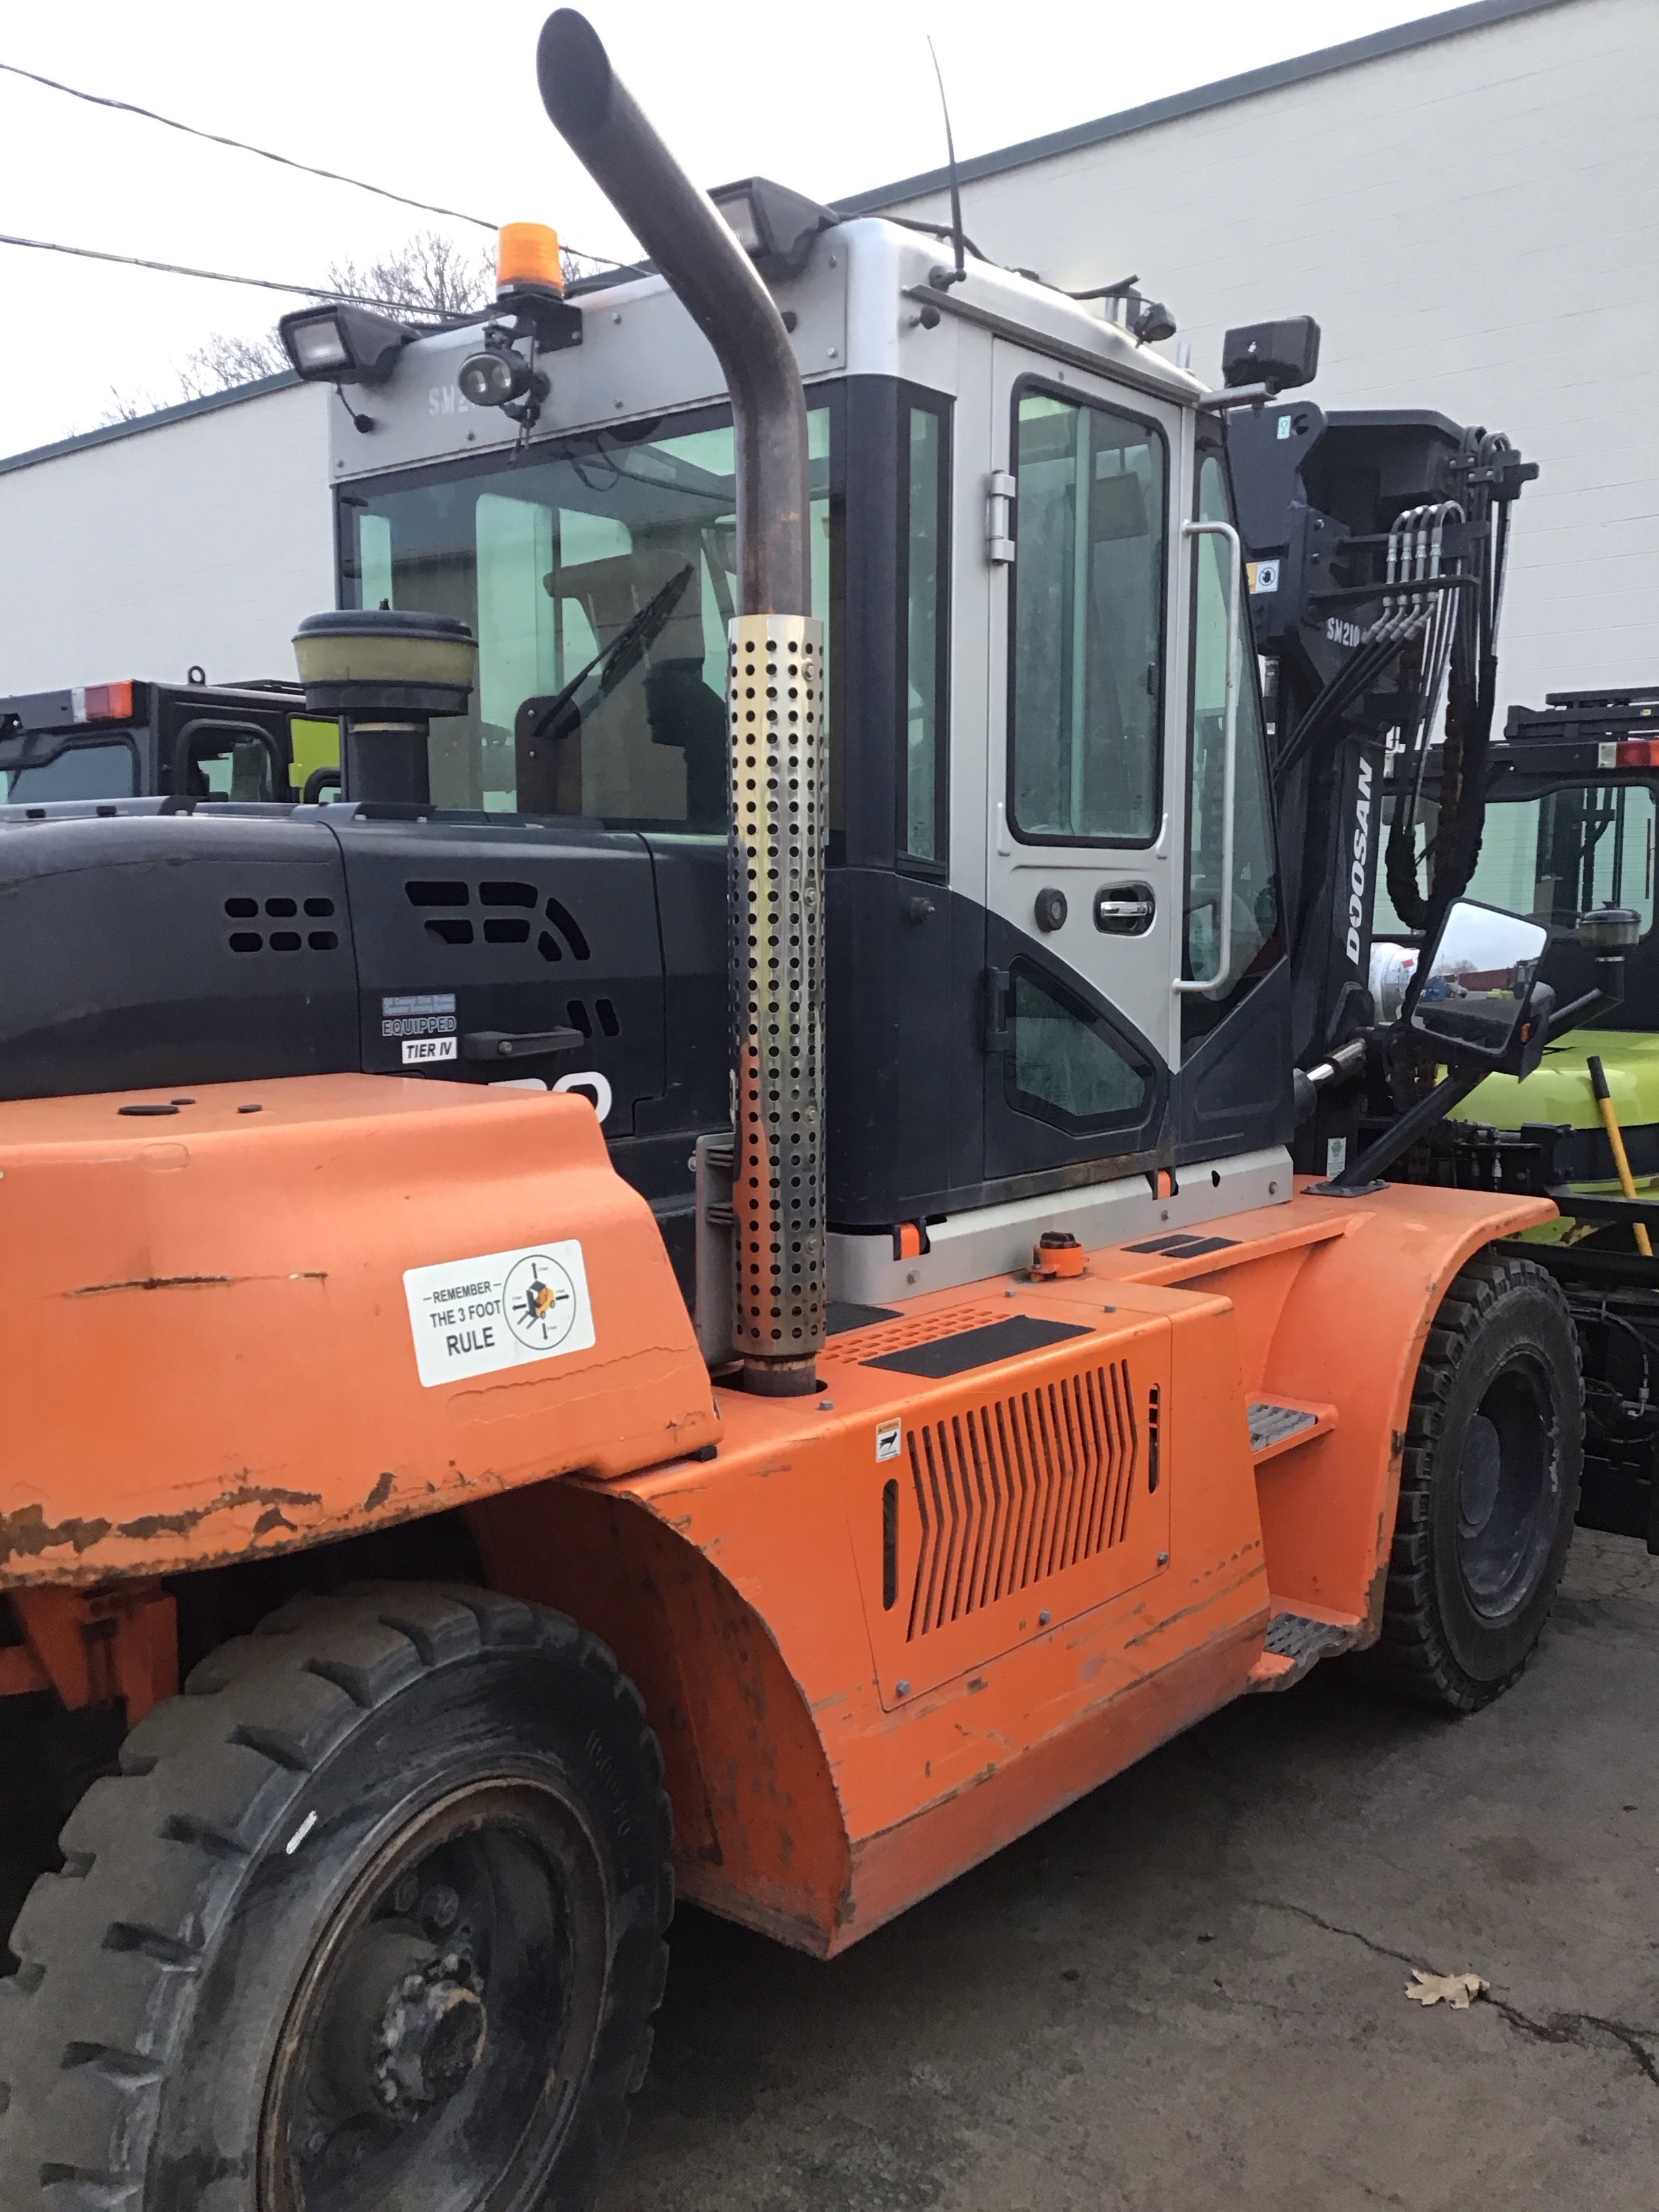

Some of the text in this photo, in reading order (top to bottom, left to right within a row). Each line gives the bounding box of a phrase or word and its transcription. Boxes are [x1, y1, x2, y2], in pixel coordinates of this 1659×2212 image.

[1346, 756, 1372, 966] DOOSAN
[382, 1016, 457, 1037] EQUIPPED
[406, 1041, 453, 1059] TIER IV
[433, 1281, 492, 1303] REMEMBER
[430, 1299, 501, 1328] THE 3 FOOT
[446, 1326, 495, 1356] RULE
